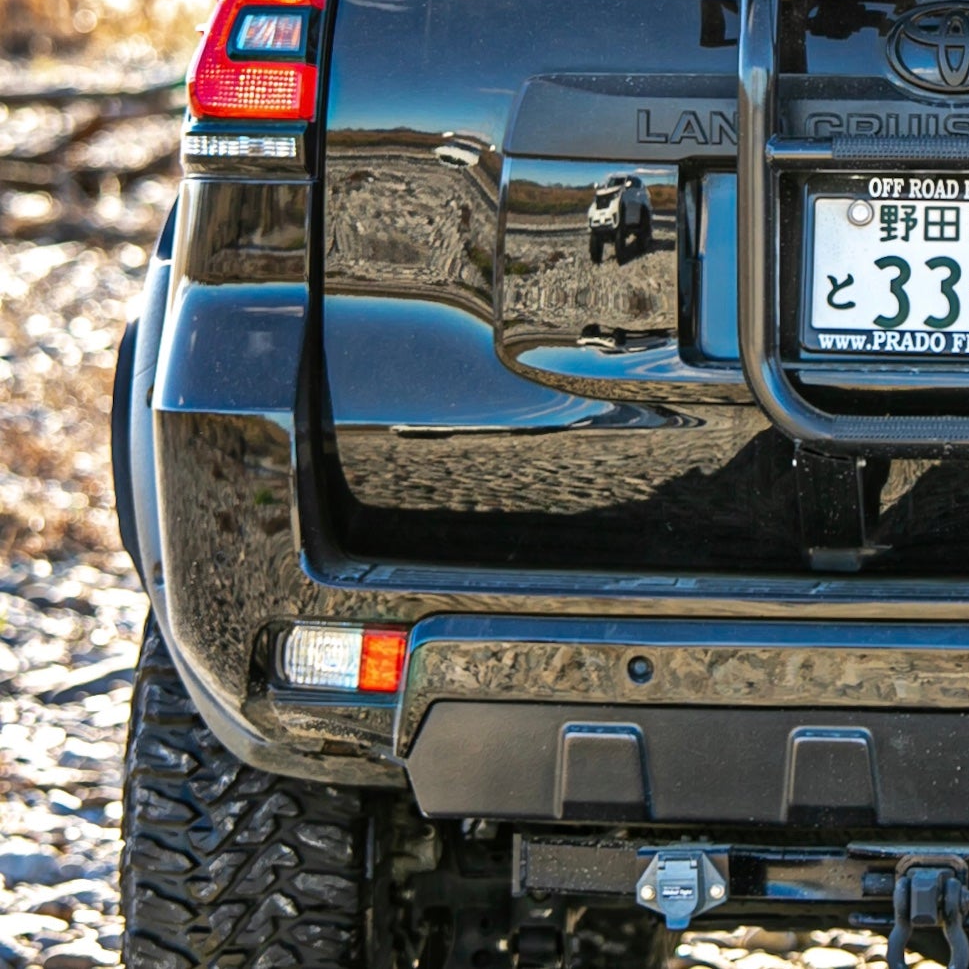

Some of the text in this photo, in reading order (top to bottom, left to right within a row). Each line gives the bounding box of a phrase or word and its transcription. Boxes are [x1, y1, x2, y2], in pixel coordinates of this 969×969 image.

[636, 109, 785, 146] LAN
[868, 177, 903, 198] OFF
[908, 178, 960, 200] ROAD
[879, 204, 960, 243] 野田
[826, 273, 857, 310] と
[818, 331, 947, 352] www.PRADO
